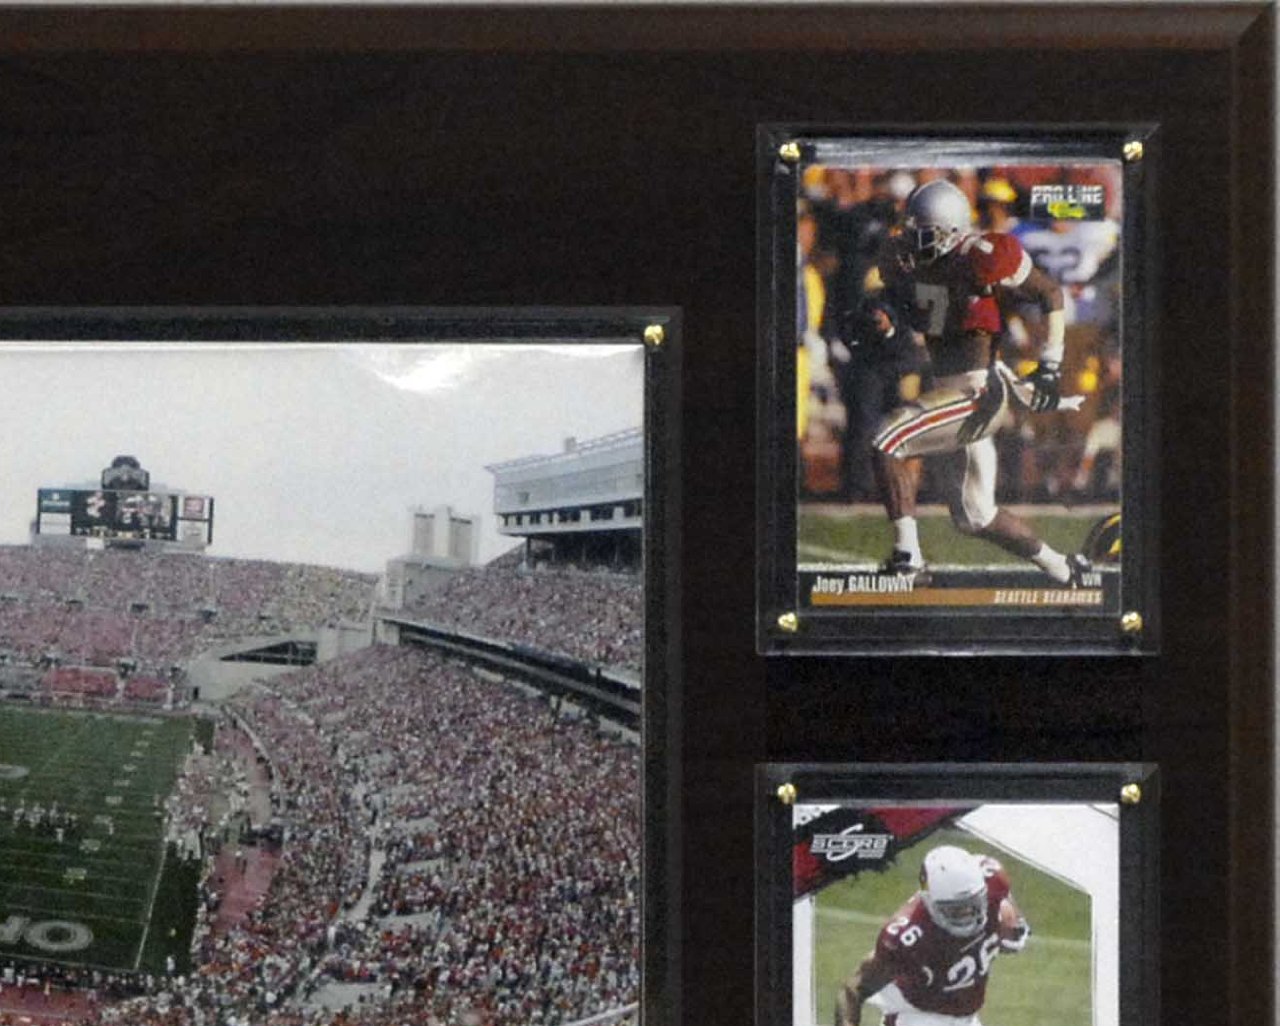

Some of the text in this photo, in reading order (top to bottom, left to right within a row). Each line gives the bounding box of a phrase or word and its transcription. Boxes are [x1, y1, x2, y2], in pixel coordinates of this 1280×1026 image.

[1031, 185, 1103, 204] PRO LINE
[812, 571, 917, 596] Joey GALLOWAY
[994, 590, 1038, 605] SEATTLE
[886, 915, 924, 948] 26
